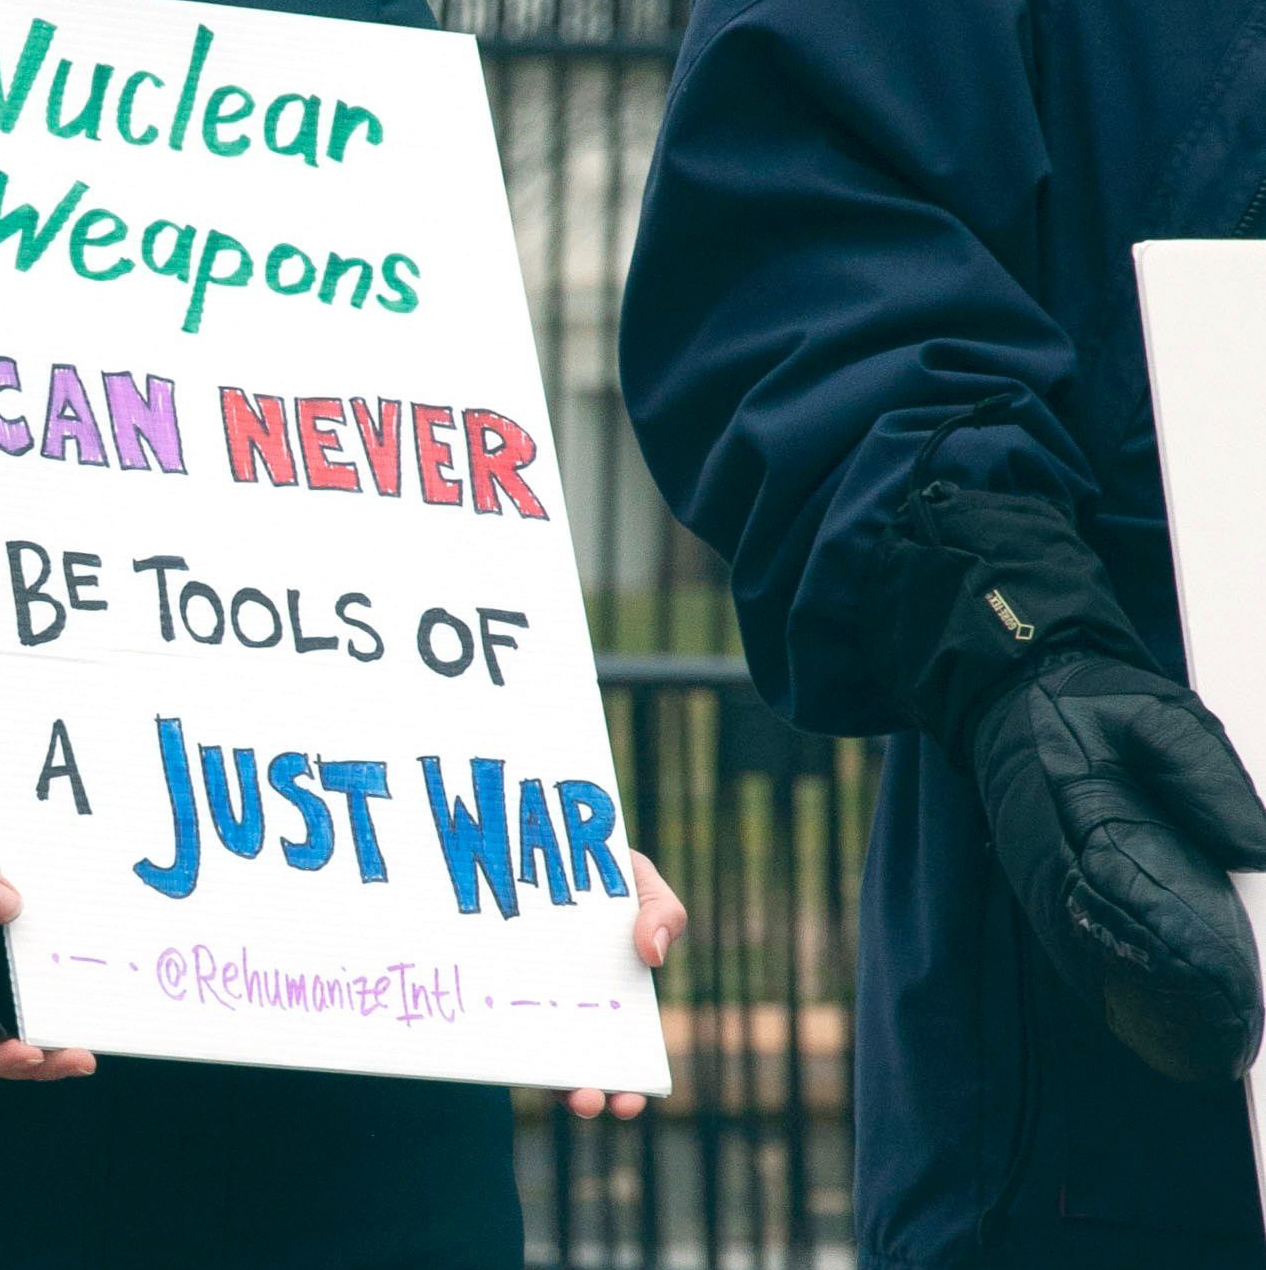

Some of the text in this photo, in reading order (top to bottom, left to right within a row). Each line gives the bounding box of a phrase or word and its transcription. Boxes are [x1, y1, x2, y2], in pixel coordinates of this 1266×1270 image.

[218, 385, 550, 521] NEVER
[6, 541, 530, 686] BE TOOLS OF
[36, 714, 629, 921] A JUST WAR
